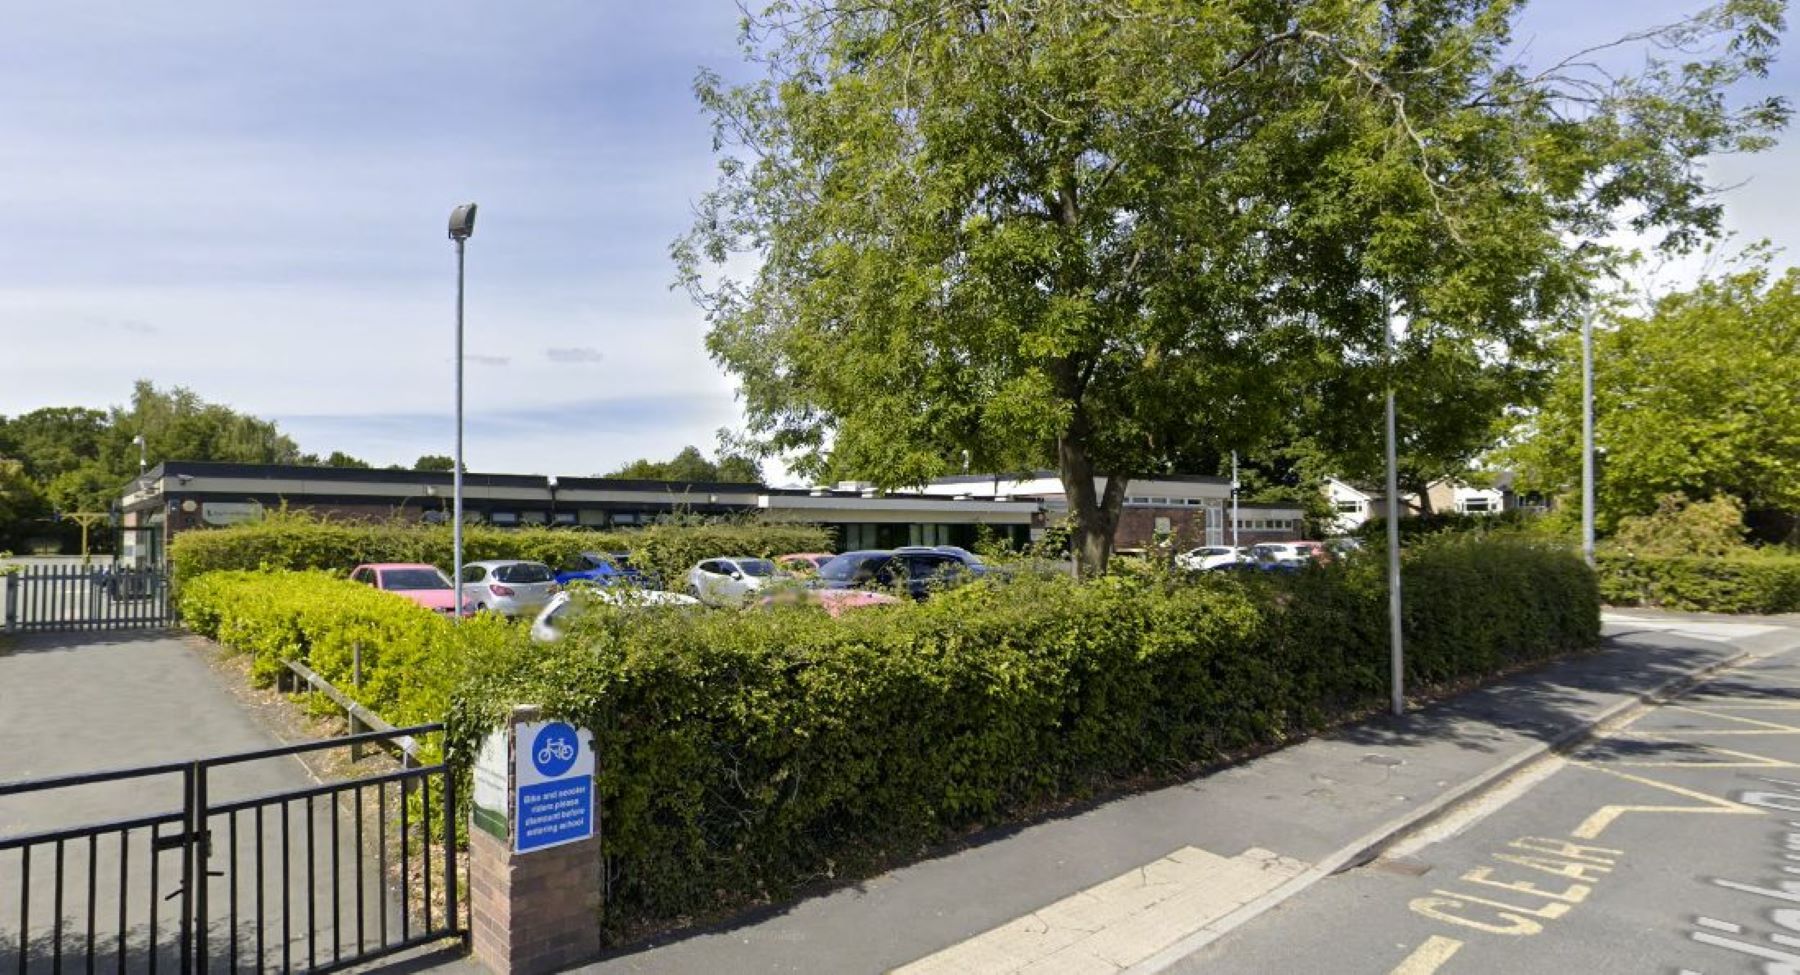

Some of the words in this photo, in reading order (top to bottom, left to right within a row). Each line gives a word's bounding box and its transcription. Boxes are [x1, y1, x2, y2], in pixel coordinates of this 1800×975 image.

[523, 795, 541, 804] Bike
[543, 791, 557, 800] and
[558, 786, 586, 797] scooter
[531, 803, 553, 813] riders
[554, 798, 579, 811] please
[525, 811, 561, 826] dismount
[561, 807, 585, 818] before
[526, 824, 558, 836] entering
[559, 818, 584, 830] school
[1408, 836, 1624, 936] CLEAR
